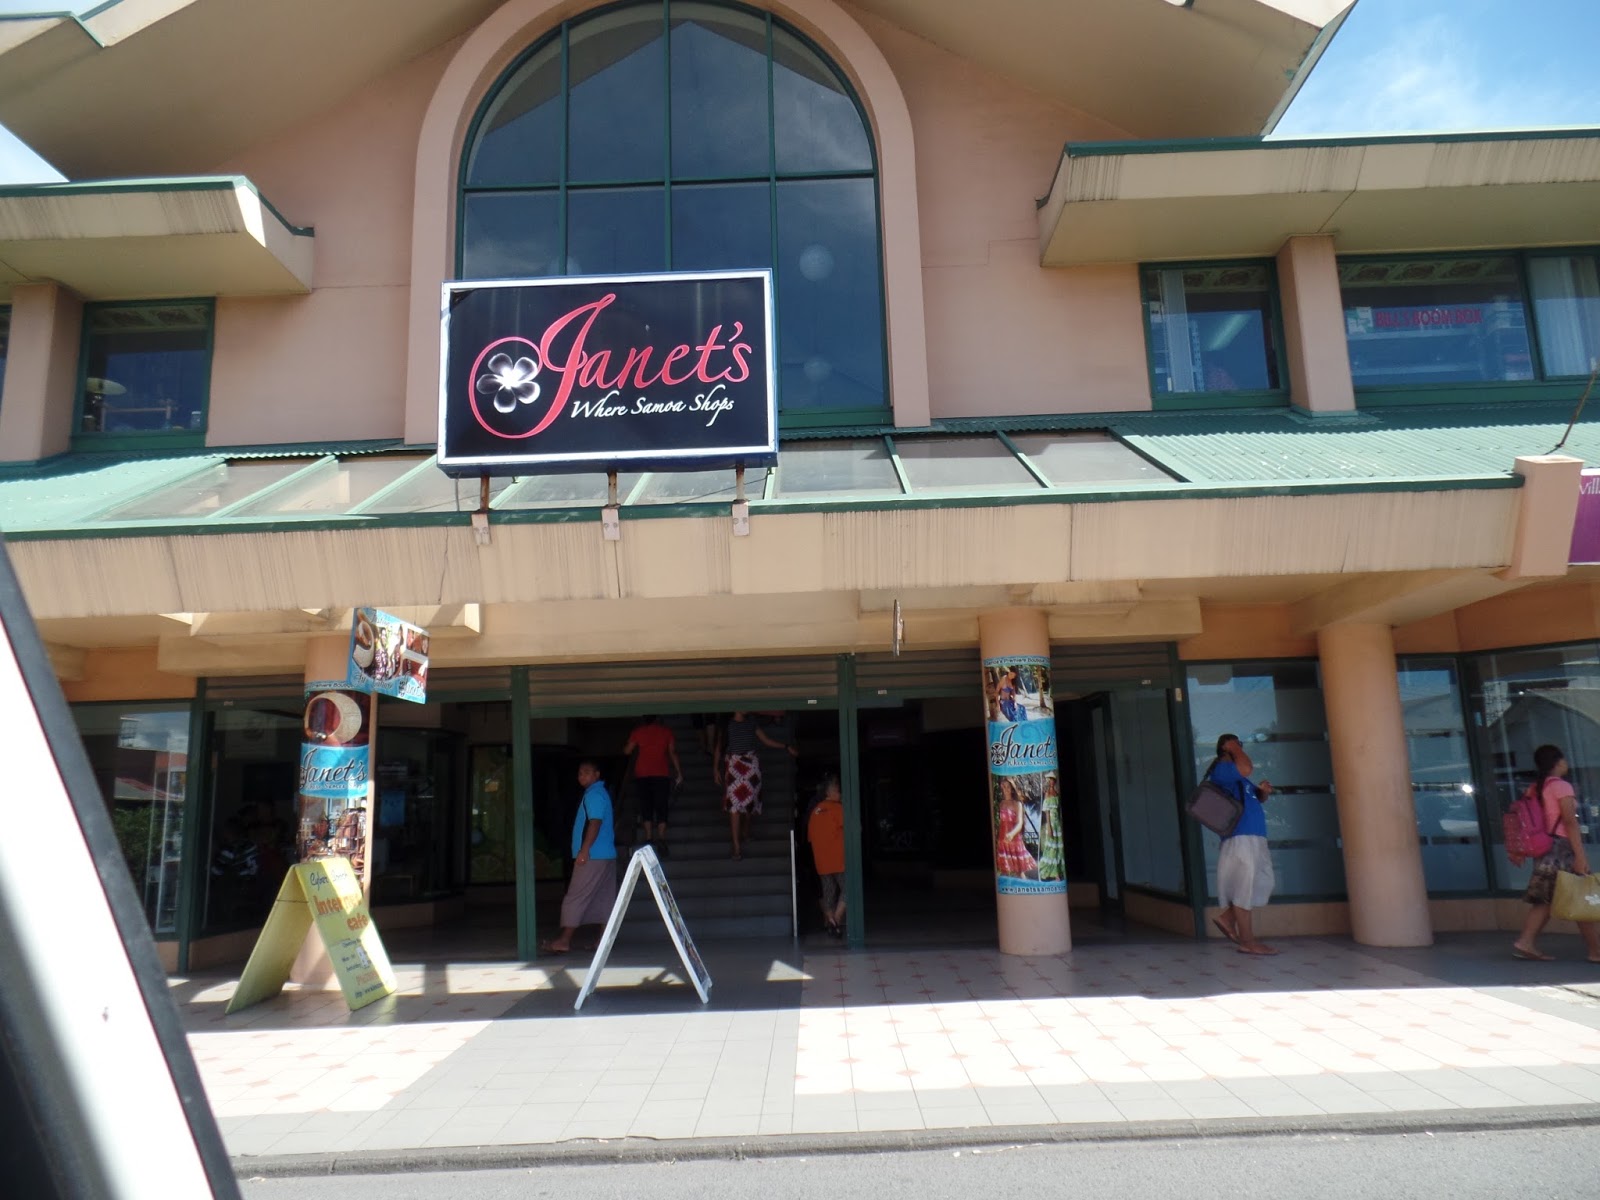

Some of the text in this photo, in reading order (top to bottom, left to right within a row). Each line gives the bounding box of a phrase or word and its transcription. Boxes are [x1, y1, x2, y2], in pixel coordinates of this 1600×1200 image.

[468, 293, 752, 439] Janet's
[571, 384, 735, 427] Where Samoa Shops
[1579, 477, 1600, 495] Vill
[300, 748, 367, 790] Janet's
